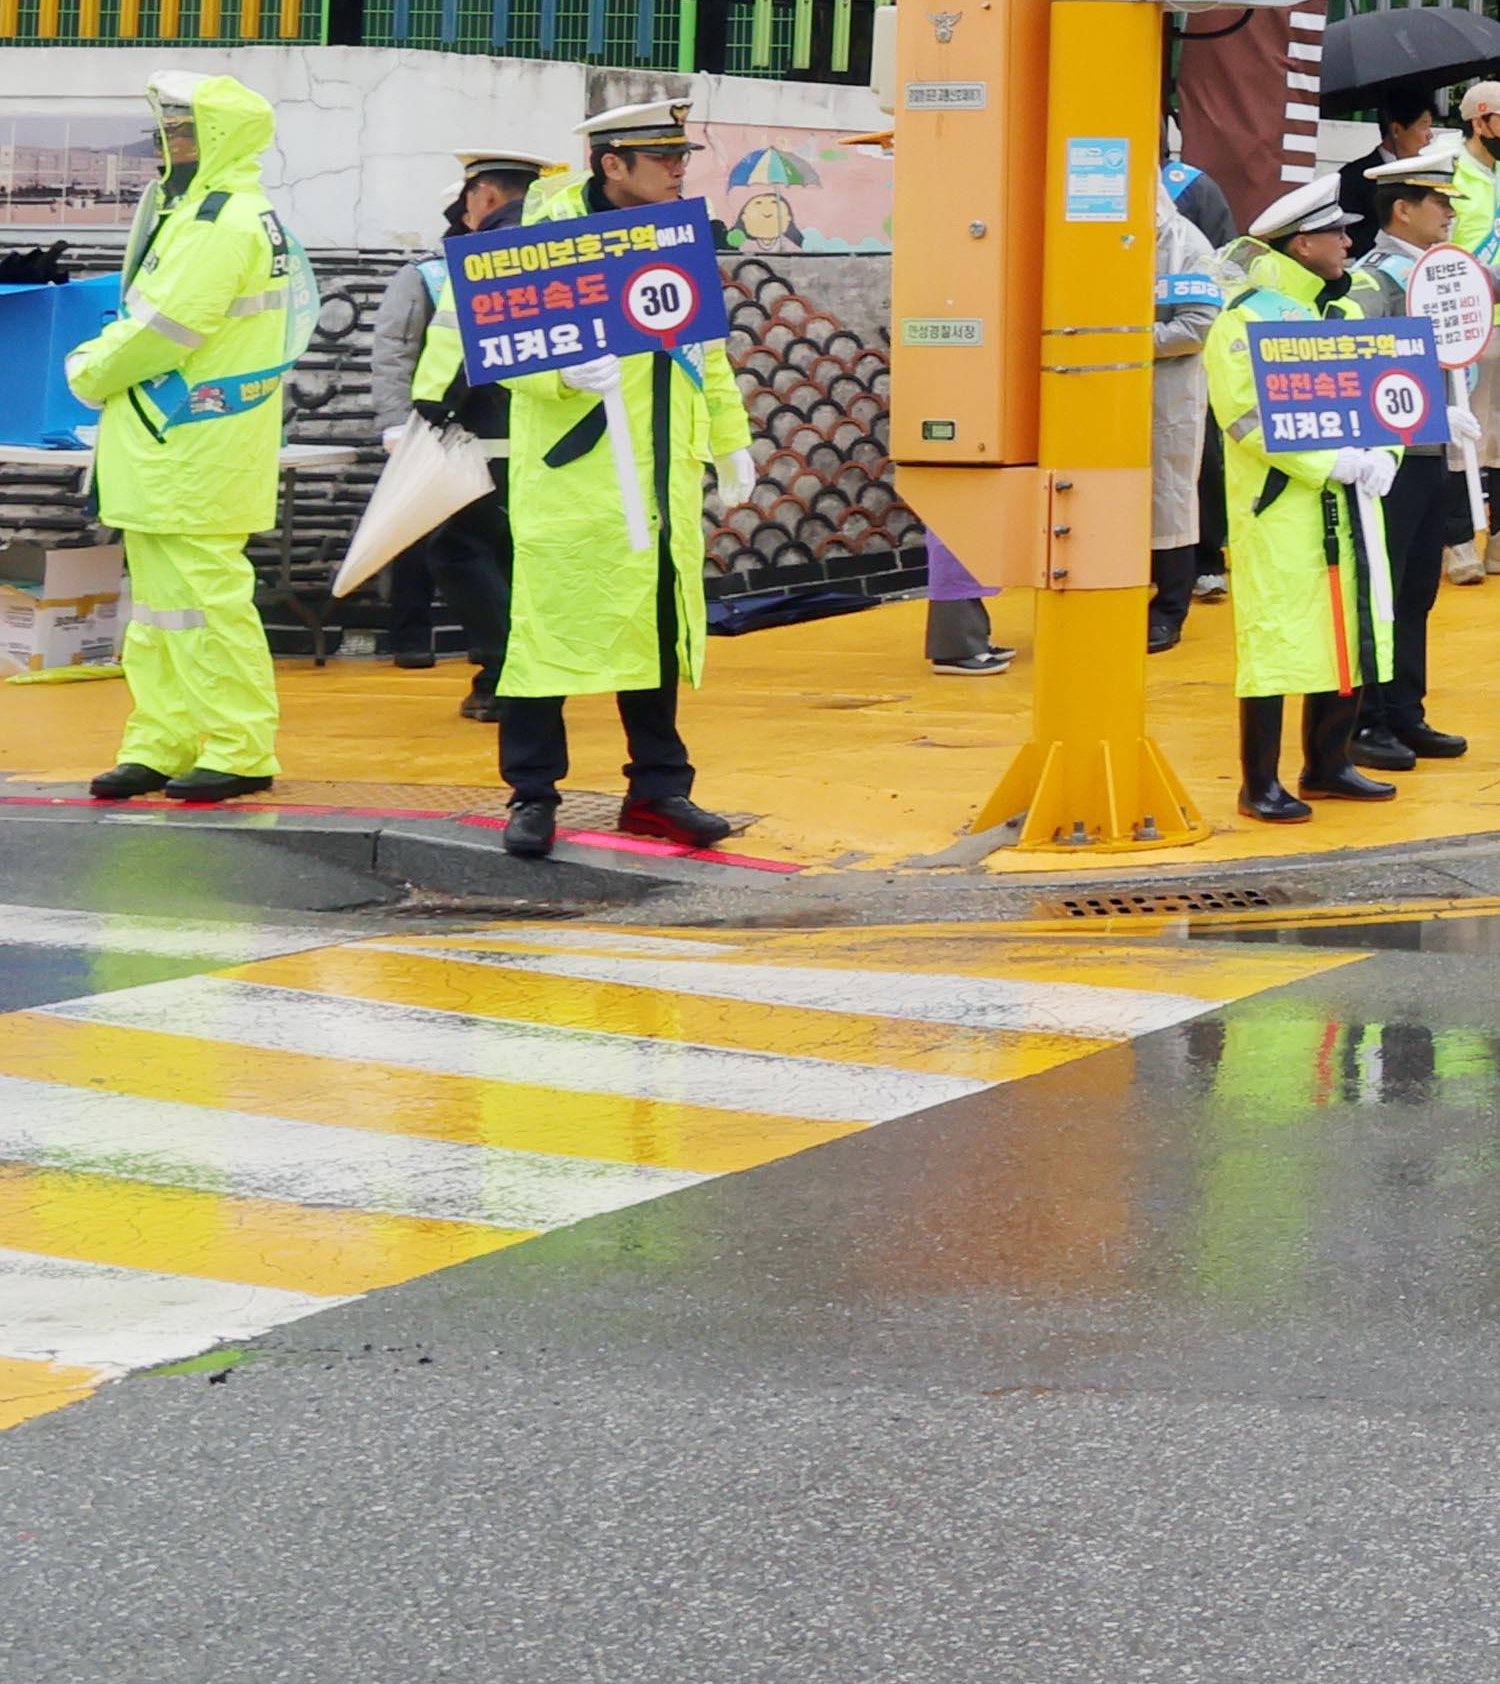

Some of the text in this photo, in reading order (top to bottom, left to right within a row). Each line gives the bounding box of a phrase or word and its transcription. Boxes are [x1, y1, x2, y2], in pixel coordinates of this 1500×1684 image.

[464, 223, 696, 282] 어린이보호구역에서
[1426, 261, 1468, 282] 횡단보도
[472, 273, 609, 326] 안전속도
[640, 282, 680, 317] 30
[1260, 334, 1426, 363] 어린이보호구역에서
[1266, 371, 1363, 402] 안전속도
[1385, 387, 1414, 415] 30
